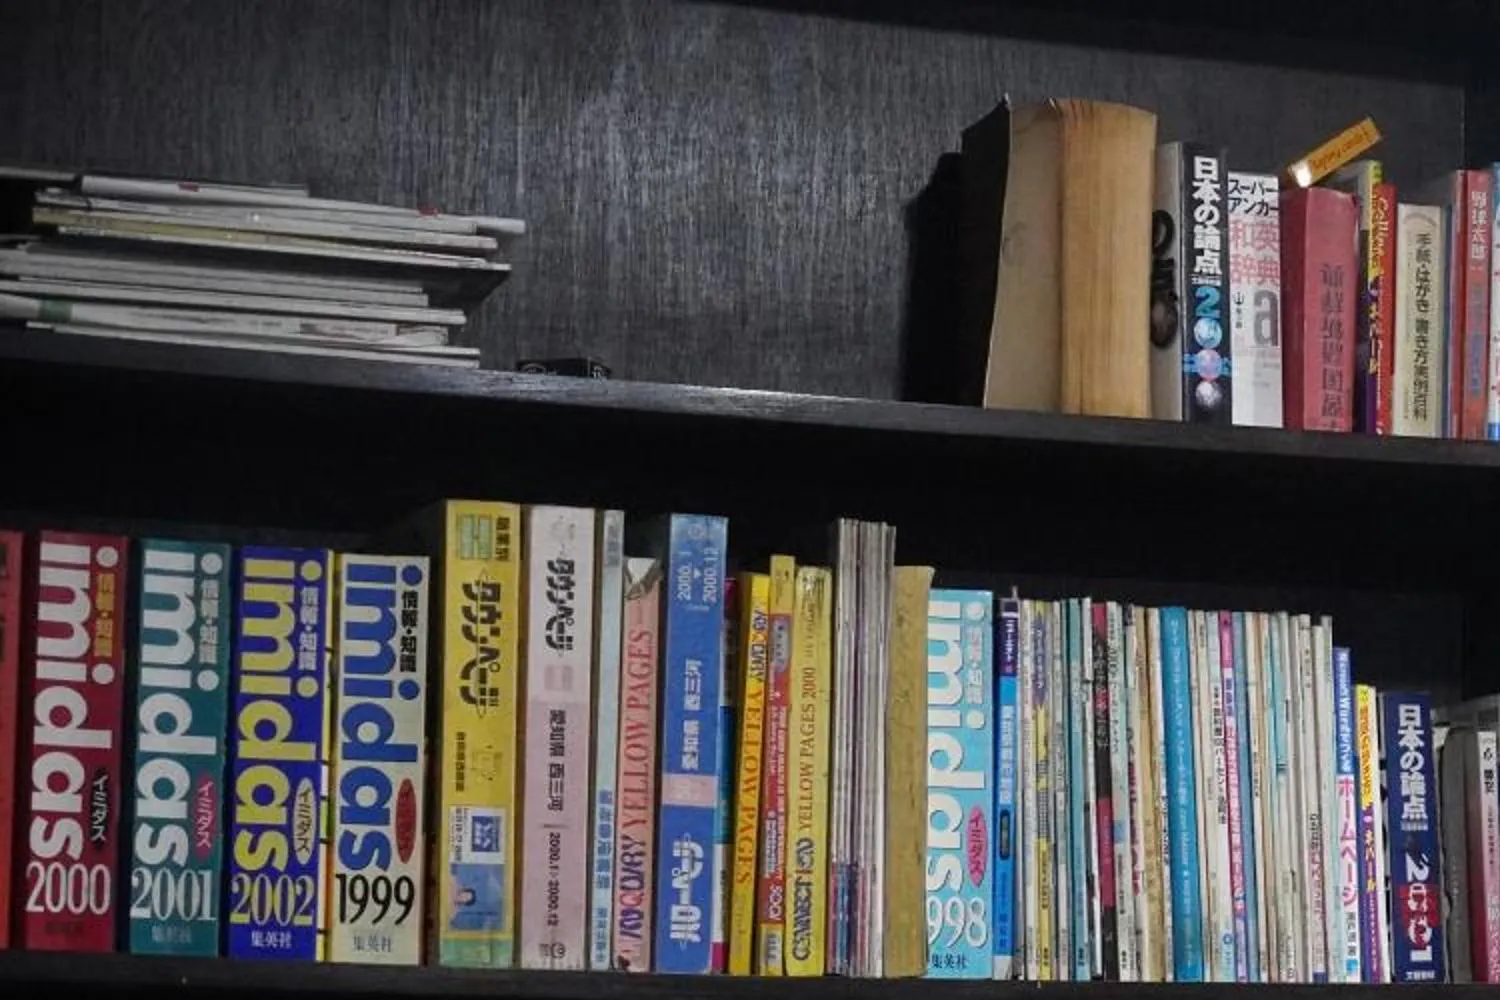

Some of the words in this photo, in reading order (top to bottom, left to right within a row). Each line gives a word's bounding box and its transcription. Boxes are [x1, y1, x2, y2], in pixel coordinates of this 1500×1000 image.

[1192, 155, 1222, 276] 日本の論点
[1228, 178, 1280, 196] スーパー
[1228, 198, 1280, 217] アンカー
[1229, 218, 1281, 251] 和英
[460, 572, 504, 714] タウンページ
[544, 556, 578, 657] タウンページ
[29, 541, 119, 861] imidas
[134, 549, 225, 868] imidas
[233, 557, 324, 872] imidas
[337, 561, 426, 874] imidas
[627, 627, 654, 723] PAGES
[802, 665, 817, 698] 2000
[742, 690, 763, 801] YELLOW
[800, 702, 816, 763] PAGES
[927, 600, 988, 892] imidas
[1398, 703, 1429, 823] 日本の論点
[623, 727, 650, 834] YELLOW
[797, 765, 815, 834] YELLOW
[26, 860, 112, 915] 2000
[735, 806, 757, 885] PAGES
[131, 868, 219, 922] 2001
[230, 873, 315, 926] 2002
[335, 872, 417, 926] 1999
[668, 834, 706, 946] ハローページ
[250, 929, 293, 949] 集英社
[931, 952, 968, 970] 集英社
